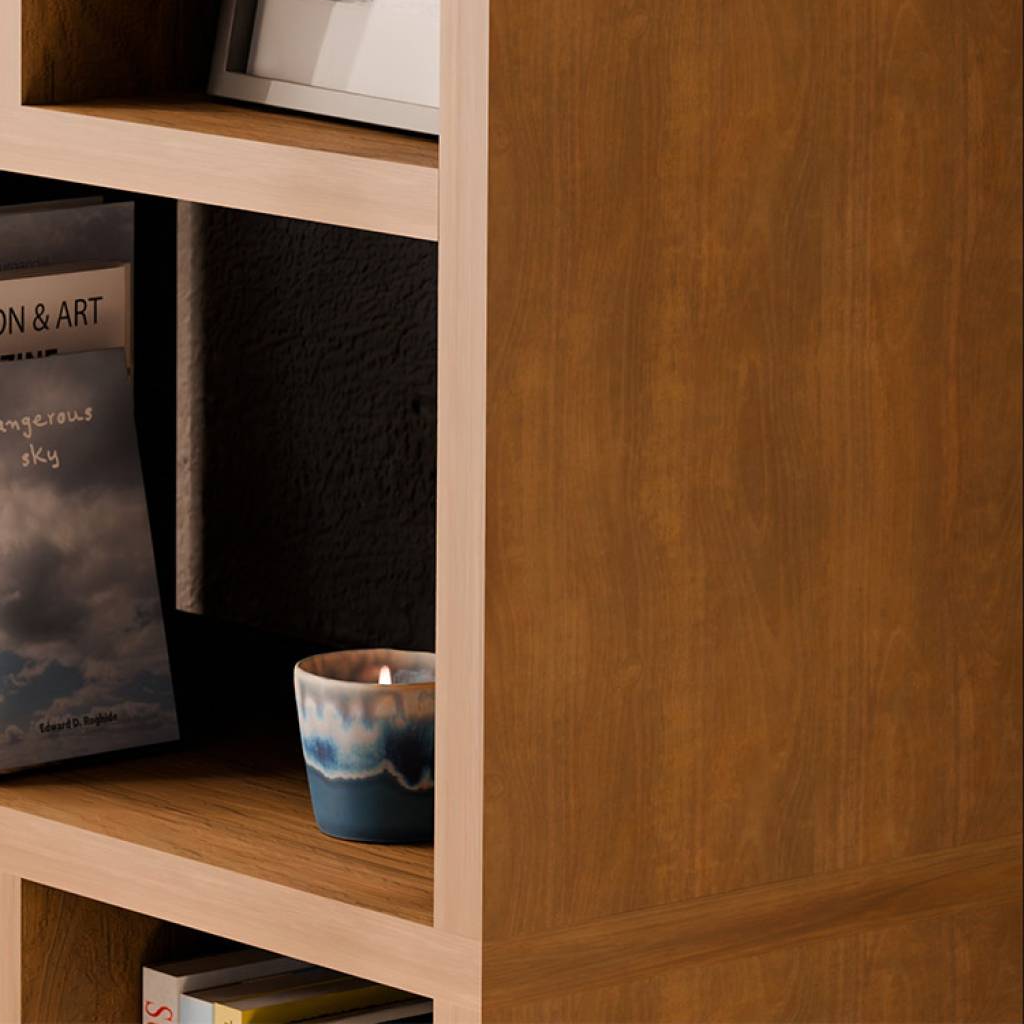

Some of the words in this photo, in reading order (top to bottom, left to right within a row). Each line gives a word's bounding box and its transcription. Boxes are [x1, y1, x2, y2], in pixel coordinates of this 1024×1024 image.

[32, 303, 49, 332] &
[56, 296, 103, 329] ART
[22, 443, 60, 469] sky
[39, 718, 72, 733] Edward
